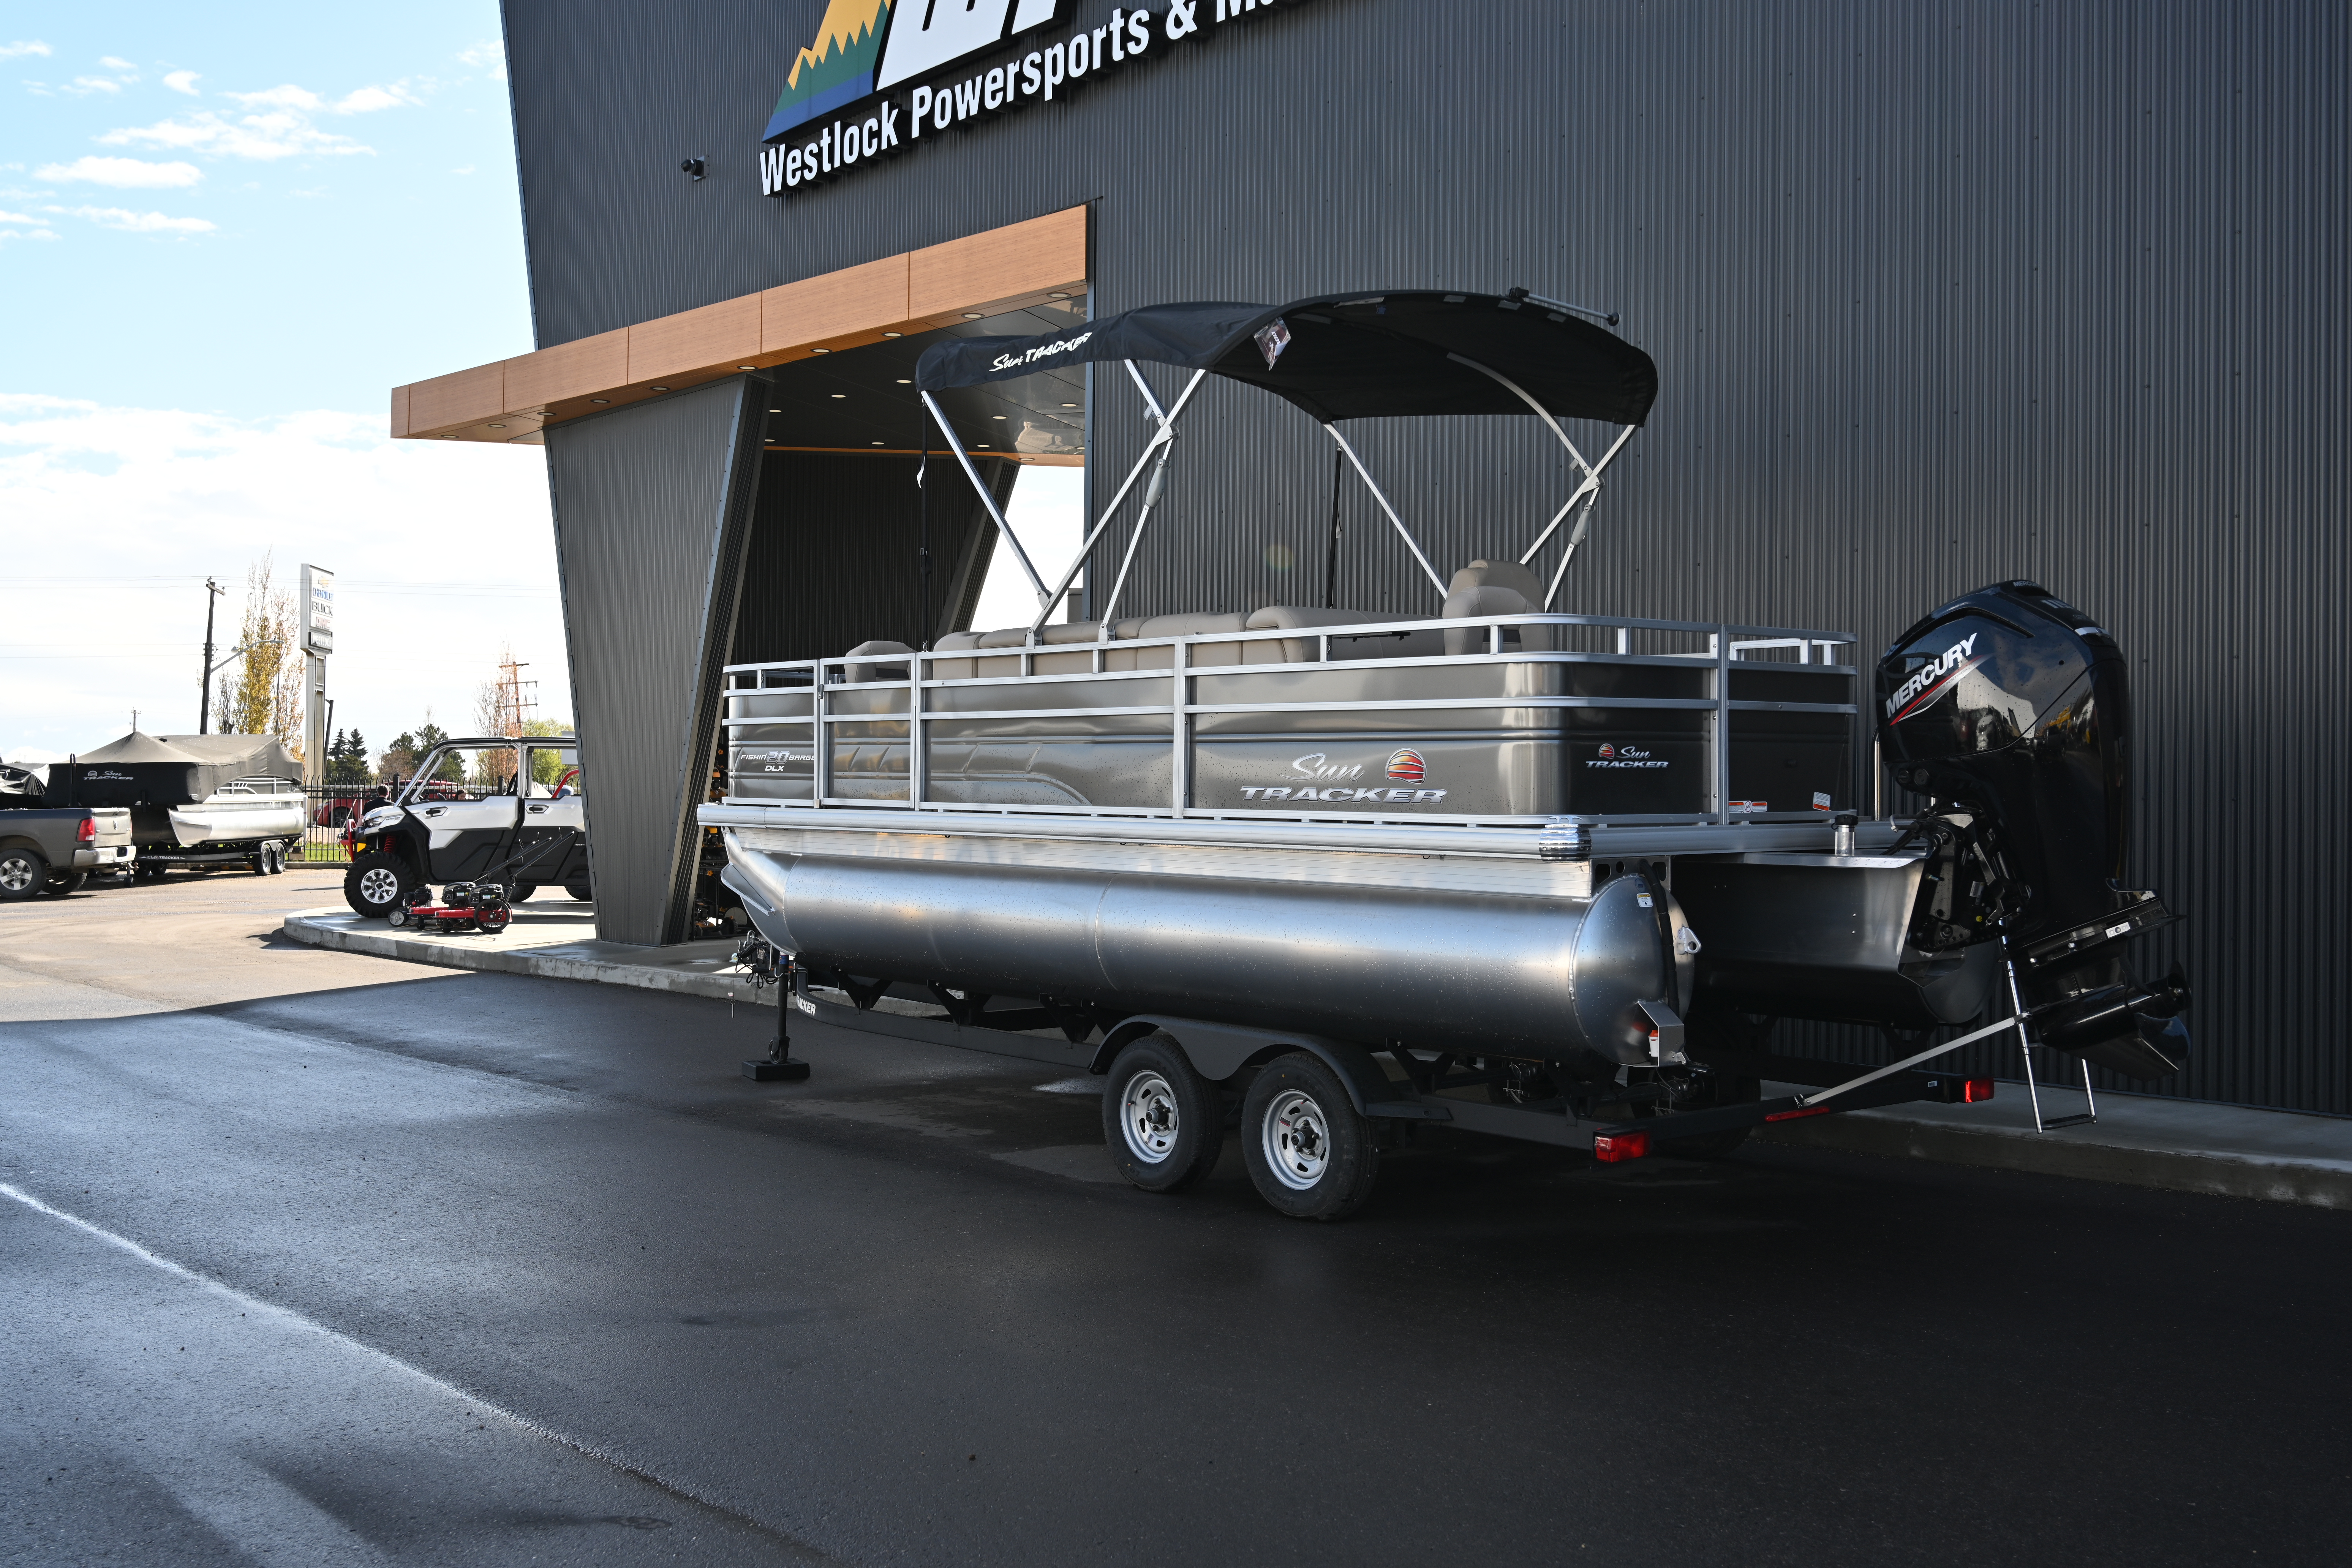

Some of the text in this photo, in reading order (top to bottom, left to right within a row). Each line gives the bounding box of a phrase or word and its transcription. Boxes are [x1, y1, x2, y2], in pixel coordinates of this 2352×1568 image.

[759, 100, 899, 196] Westlock
[912, 7, 1149, 139] Powersports
[1166, 0, 1198, 40] &
[989, 332, 1092, 371] Sun TRACKER
[313, 587, 334, 602] CHEVROLET
[312, 601, 333, 616] BUICK
[316, 616, 330, 629] GMC
[313, 634, 332, 647] WESTLOCK
[1886, 632, 1977, 718] MERCURY
[765, 751, 790, 764] 20
[1616, 746, 1650, 759] Sun
[1280, 753, 1365, 781] Sun
[1240, 786, 1447, 804] TRACKER
